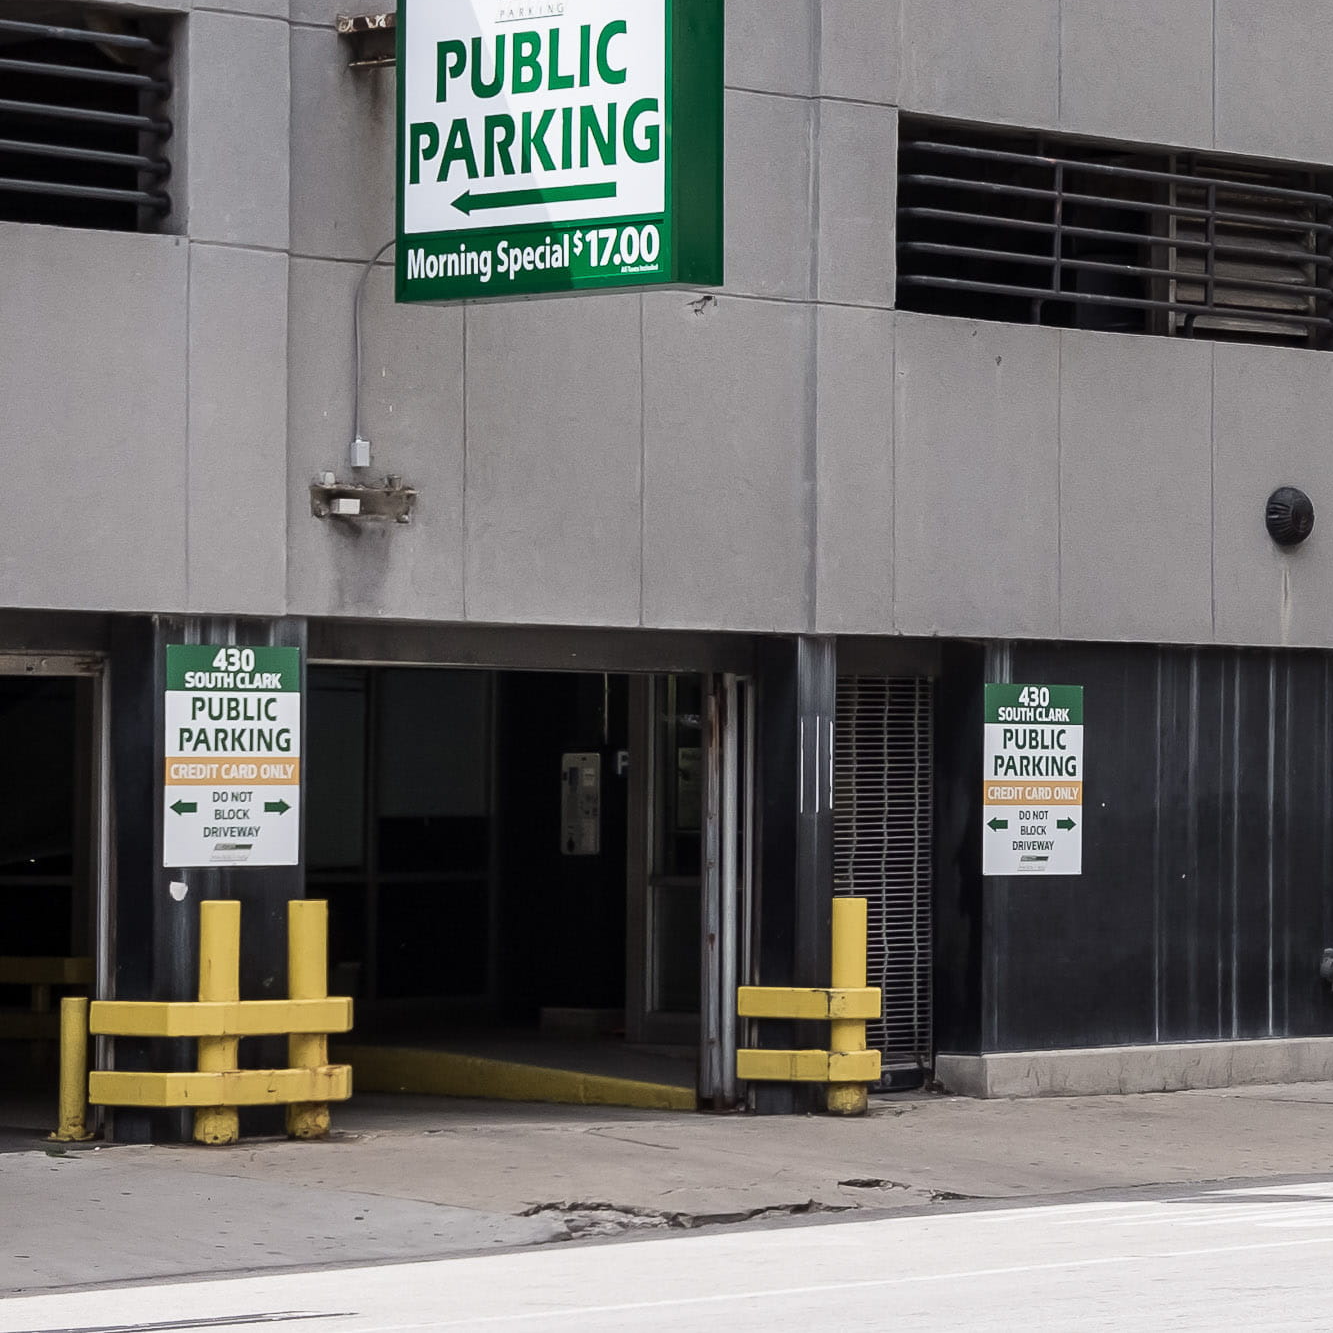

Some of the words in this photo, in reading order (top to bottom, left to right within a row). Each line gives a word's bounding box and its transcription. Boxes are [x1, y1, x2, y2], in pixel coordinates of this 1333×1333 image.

[435, 19, 628, 104] PUBLIC
[408, 96, 661, 186] PARKING
[406, 242, 493, 283] Morning
[496, 232, 570, 281] Special
[572, 224, 661, 268] $17.00
[212, 647, 255, 672] 430
[184, 671, 235, 689] SOUTH
[236, 672, 282, 690] CLARK
[1018, 686, 1050, 708] 430
[191, 696, 278, 722] PUBLIC
[997, 706, 1036, 722] SOUTH
[1037, 707, 1070, 723] CLARK
[178, 727, 292, 753] PARKING
[1002, 728, 1067, 750] PUBLIC
[169, 763, 219, 780] CREDIT
[221, 763, 258, 780] CARD
[260, 763, 296, 780] ONLY
[993, 754, 1077, 778] PARKING
[212, 791, 228, 804] DO
[230, 791, 253, 804] NOT
[987, 786, 1024, 800] CREDIT
[1024, 786, 1052, 800] CARD
[1053, 786, 1080, 801] ONLY
[214, 808, 251, 820] BLOCK
[1018, 810, 1031, 821] DO
[1032, 810, 1049, 821] NOT
[202, 825, 261, 838] DRIVEWAY
[1020, 825, 1047, 836] BLOCK
[1012, 840, 1055, 852] DRIVEWAY
